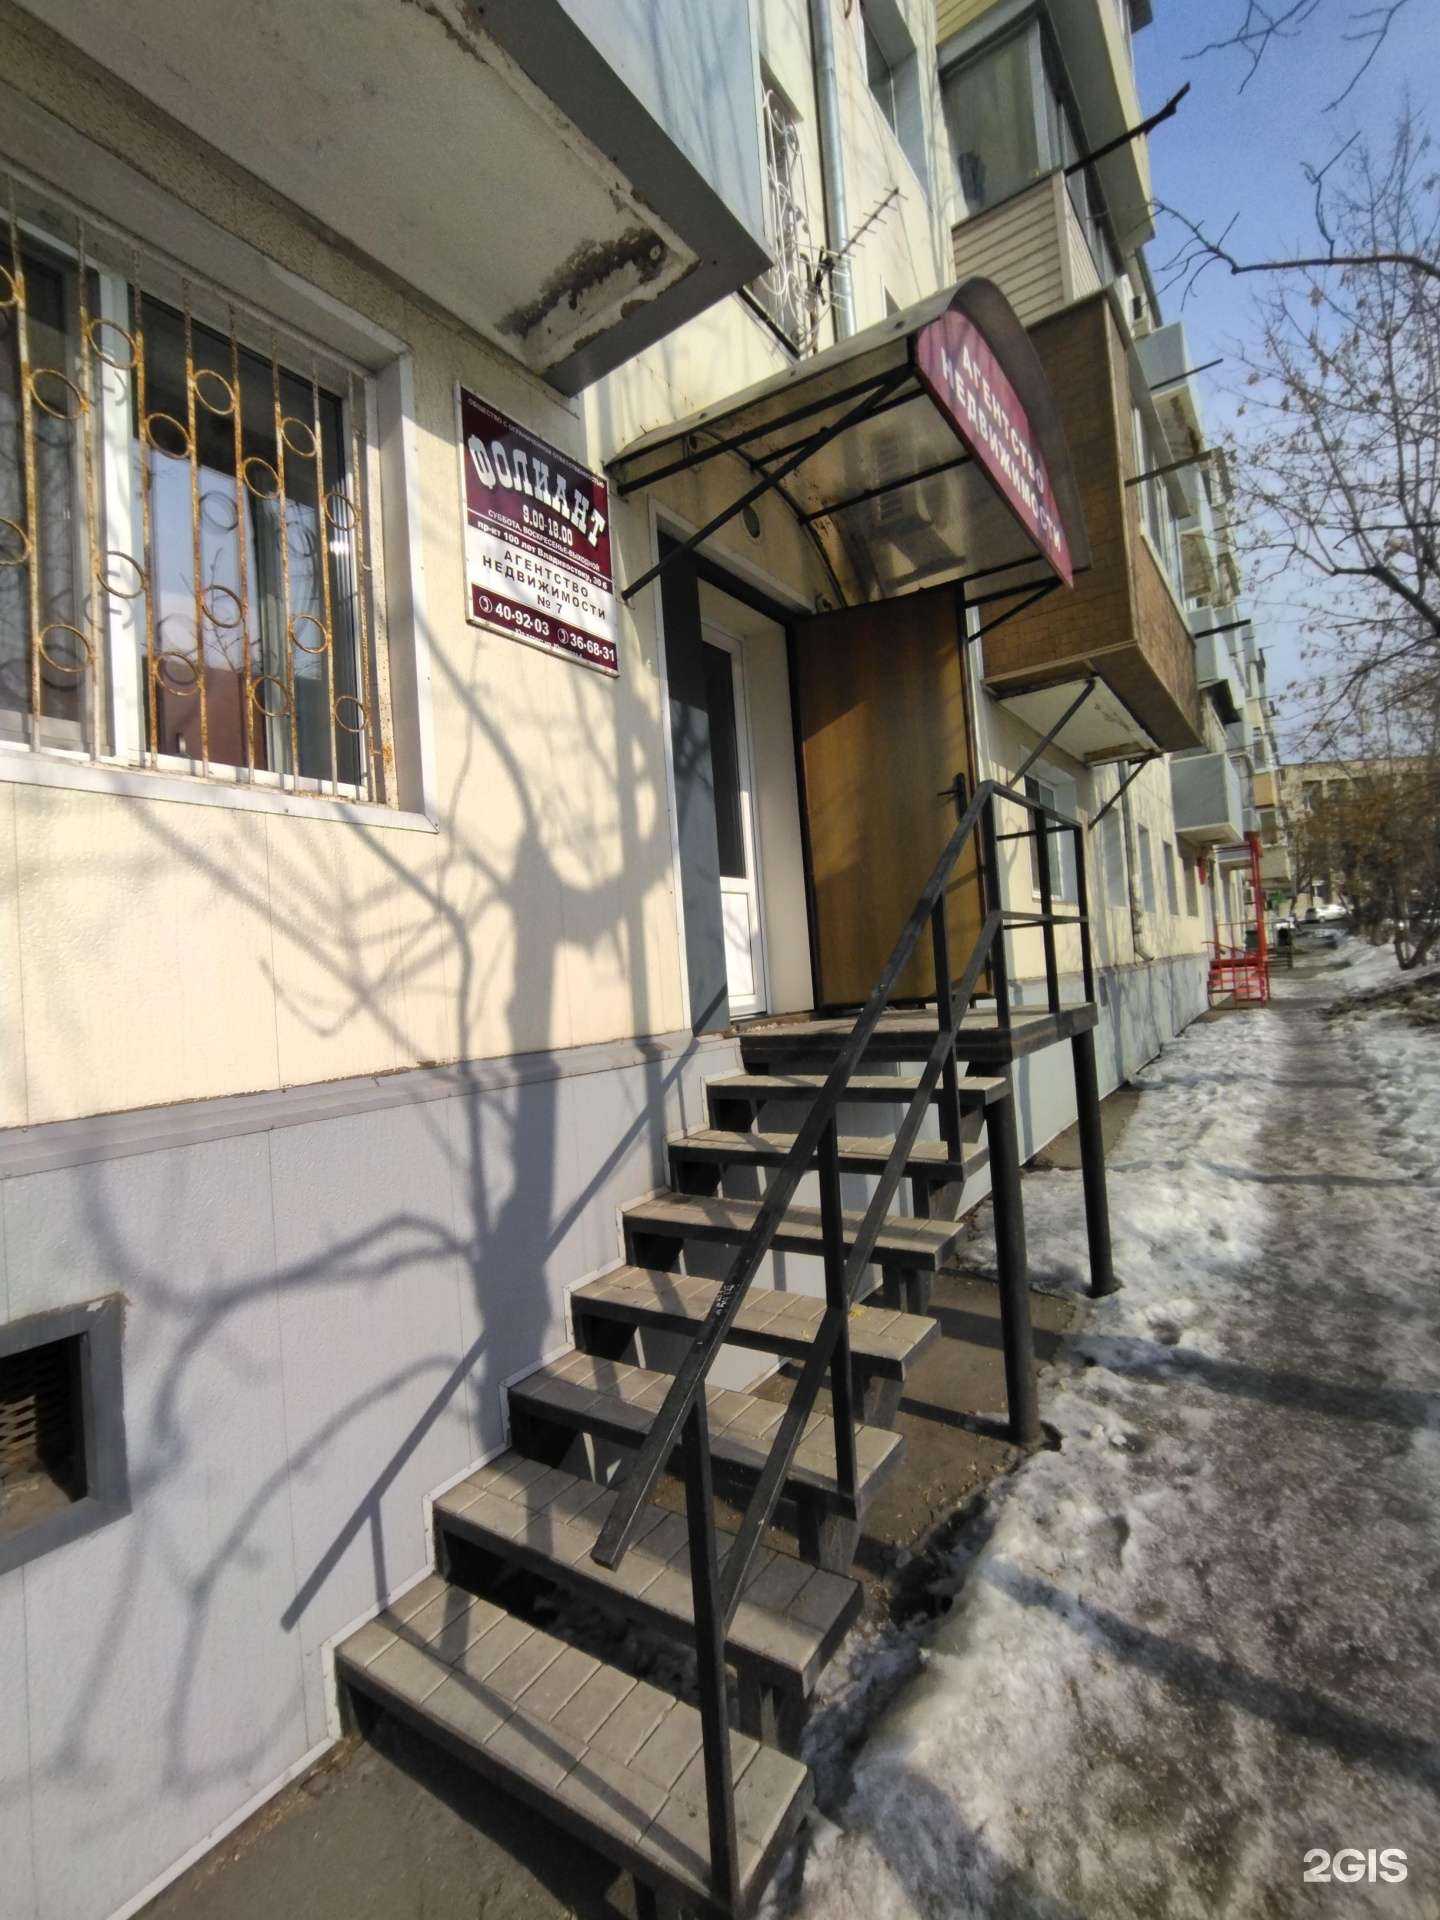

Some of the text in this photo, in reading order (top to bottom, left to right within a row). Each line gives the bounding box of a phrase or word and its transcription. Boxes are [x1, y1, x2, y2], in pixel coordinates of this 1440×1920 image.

[962, 345, 1045, 494] АГЕНТСТВО
[940, 347, 1061, 552] НЕДВИЖИМОСТИ
[467, 434, 606, 547] ФОЛИАНТ
[477, 521, 501, 537] пр-кт
[503, 532, 520, 546] 100
[521, 541, 536, 553] лет
[488, 509, 522, 532] СУББОТА,
[522, 504, 573, 546] 9.00-18.00
[482, 555, 607, 621] НЕДВИЖИМОСТИ
[504, 550, 589, 598] АГЕНТСТВО
[537, 594, 563, 614] № 7
[495, 602, 550, 637] 40-92-03
[570, 632, 615, 662] 36-68-31
